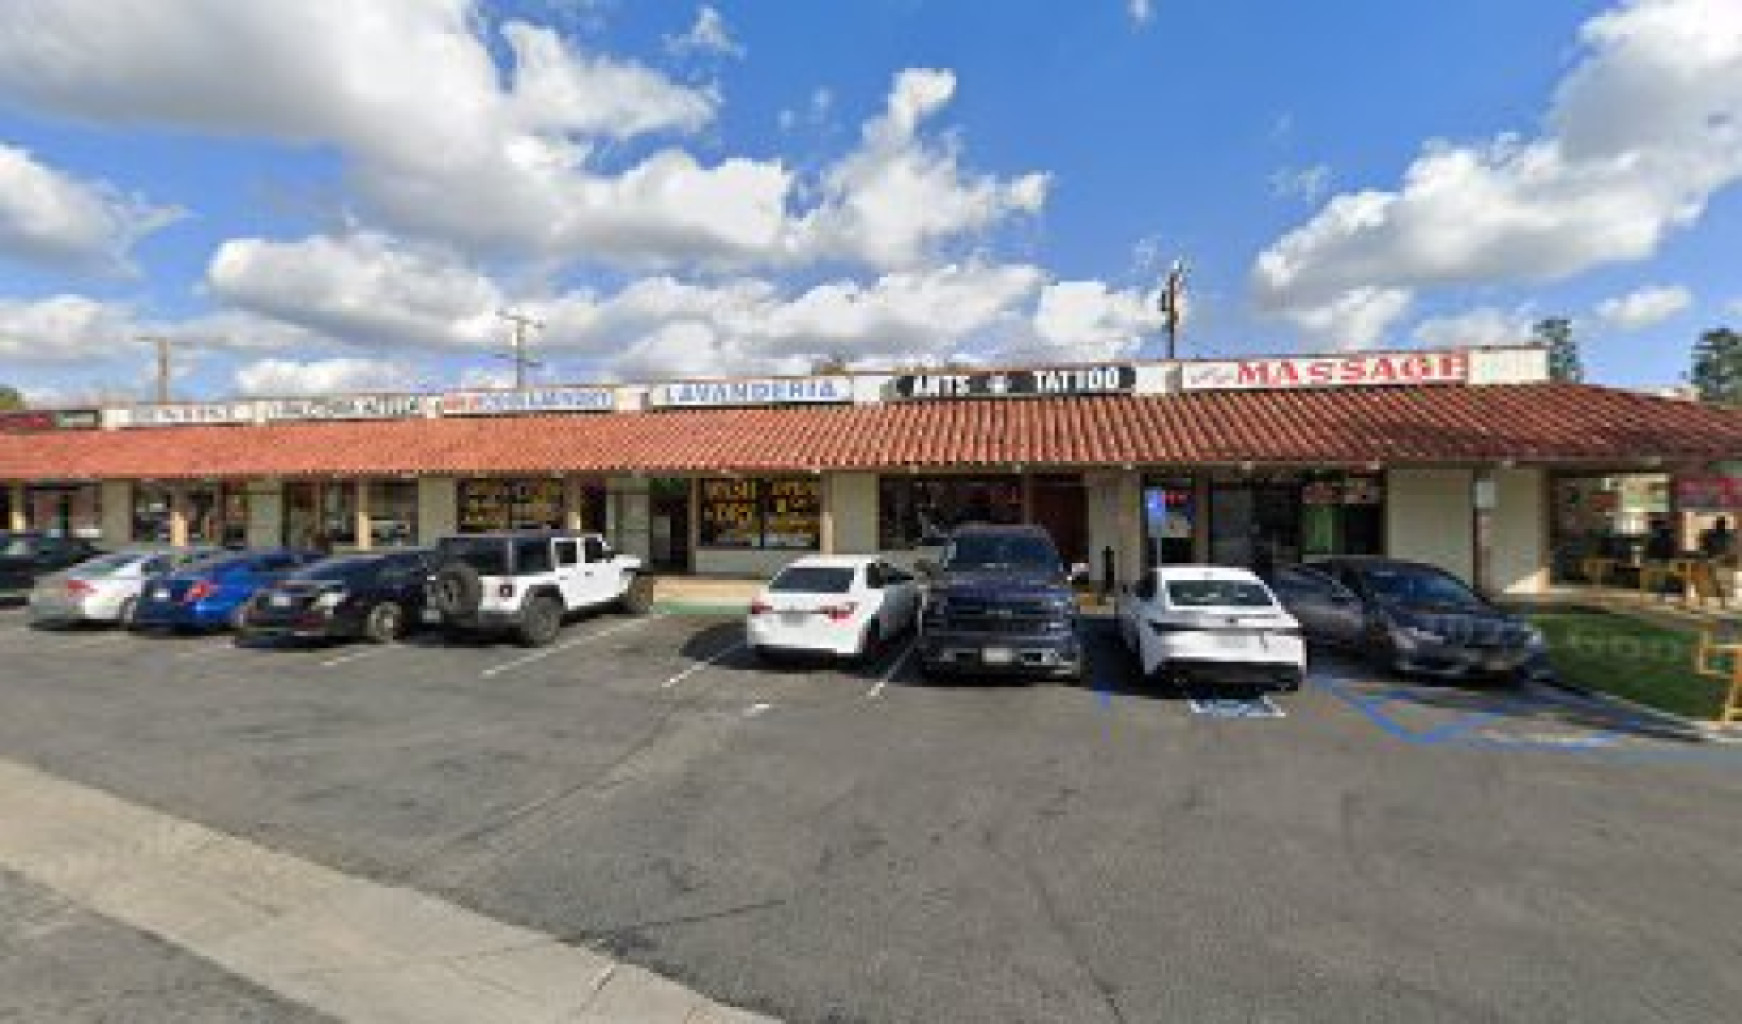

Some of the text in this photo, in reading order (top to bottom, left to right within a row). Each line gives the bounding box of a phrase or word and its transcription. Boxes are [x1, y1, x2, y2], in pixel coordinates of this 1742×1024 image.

[1033, 367, 1120, 393] TATTOO
[1237, 353, 1470, 384] MASSAGE
[665, 379, 839, 403] LAVANDERIA
